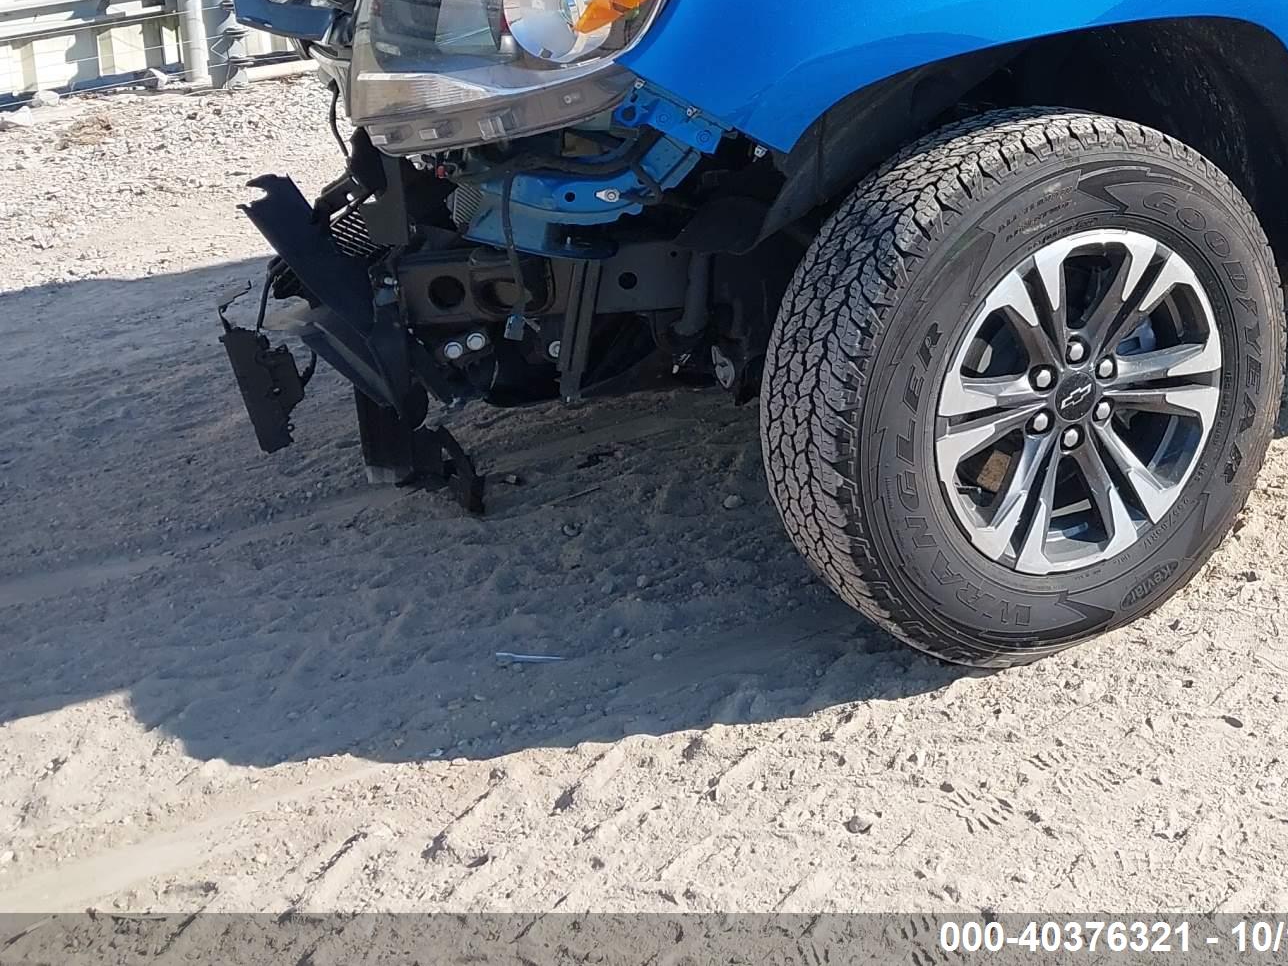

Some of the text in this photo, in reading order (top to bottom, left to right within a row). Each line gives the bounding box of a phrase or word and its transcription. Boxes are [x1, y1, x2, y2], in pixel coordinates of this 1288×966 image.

[896, 321, 1033, 627] WRANGLER
[1142, 191, 1262, 484] GOODYEAR
[1130, 564, 1172, 603] Kevlar
